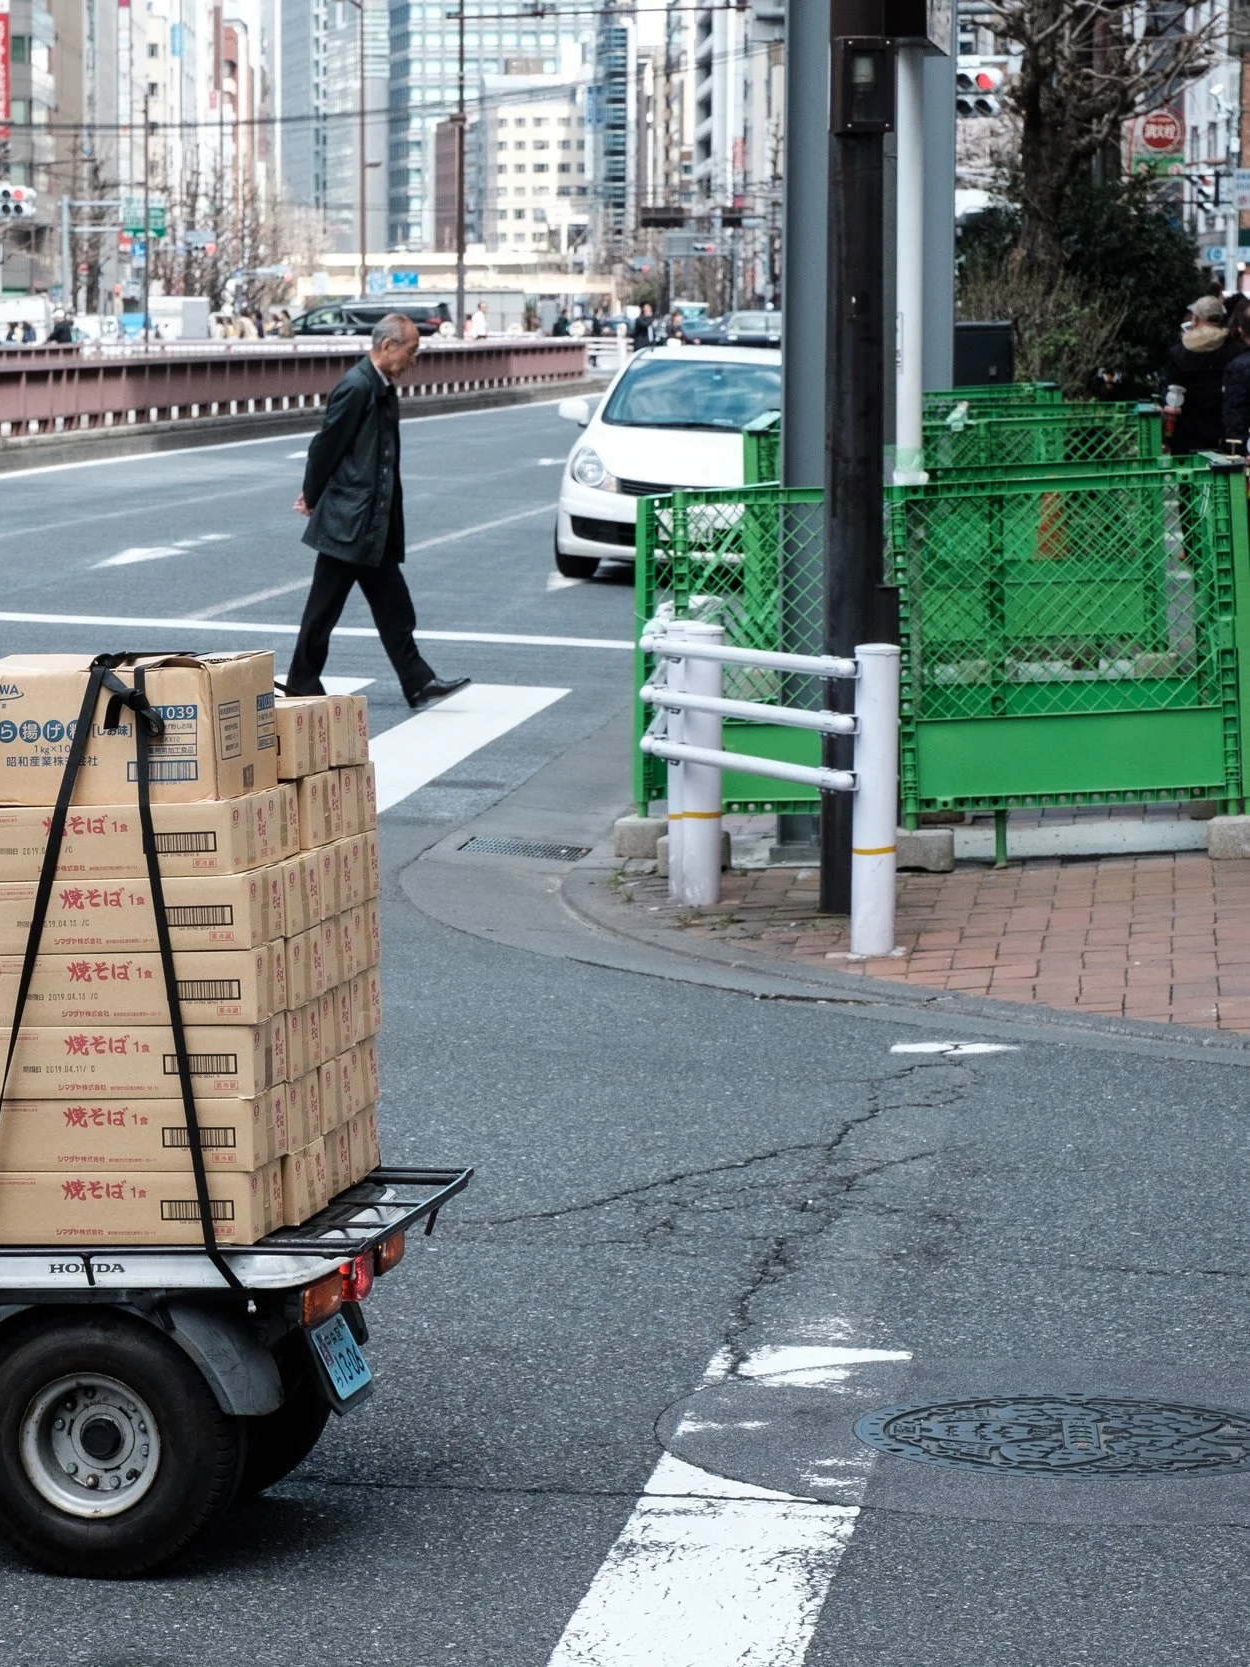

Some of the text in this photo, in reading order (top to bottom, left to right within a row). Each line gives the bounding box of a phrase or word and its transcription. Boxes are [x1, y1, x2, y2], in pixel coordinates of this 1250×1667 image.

[151, 706, 195, 719] 1039
[59, 887, 125, 910] 焼そば
[53, 937, 103, 945] シマダヤ株式会社
[66, 960, 133, 983] 焼そば
[61, 1009, 110, 1018] シマダヤ株式会社
[63, 1034, 130, 1056] 焼そば
[58, 1083, 107, 1092] シマダヤ株式会社
[63, 1106, 128, 1128] 焼そば
[61, 1178, 127, 1201] 焼そば
